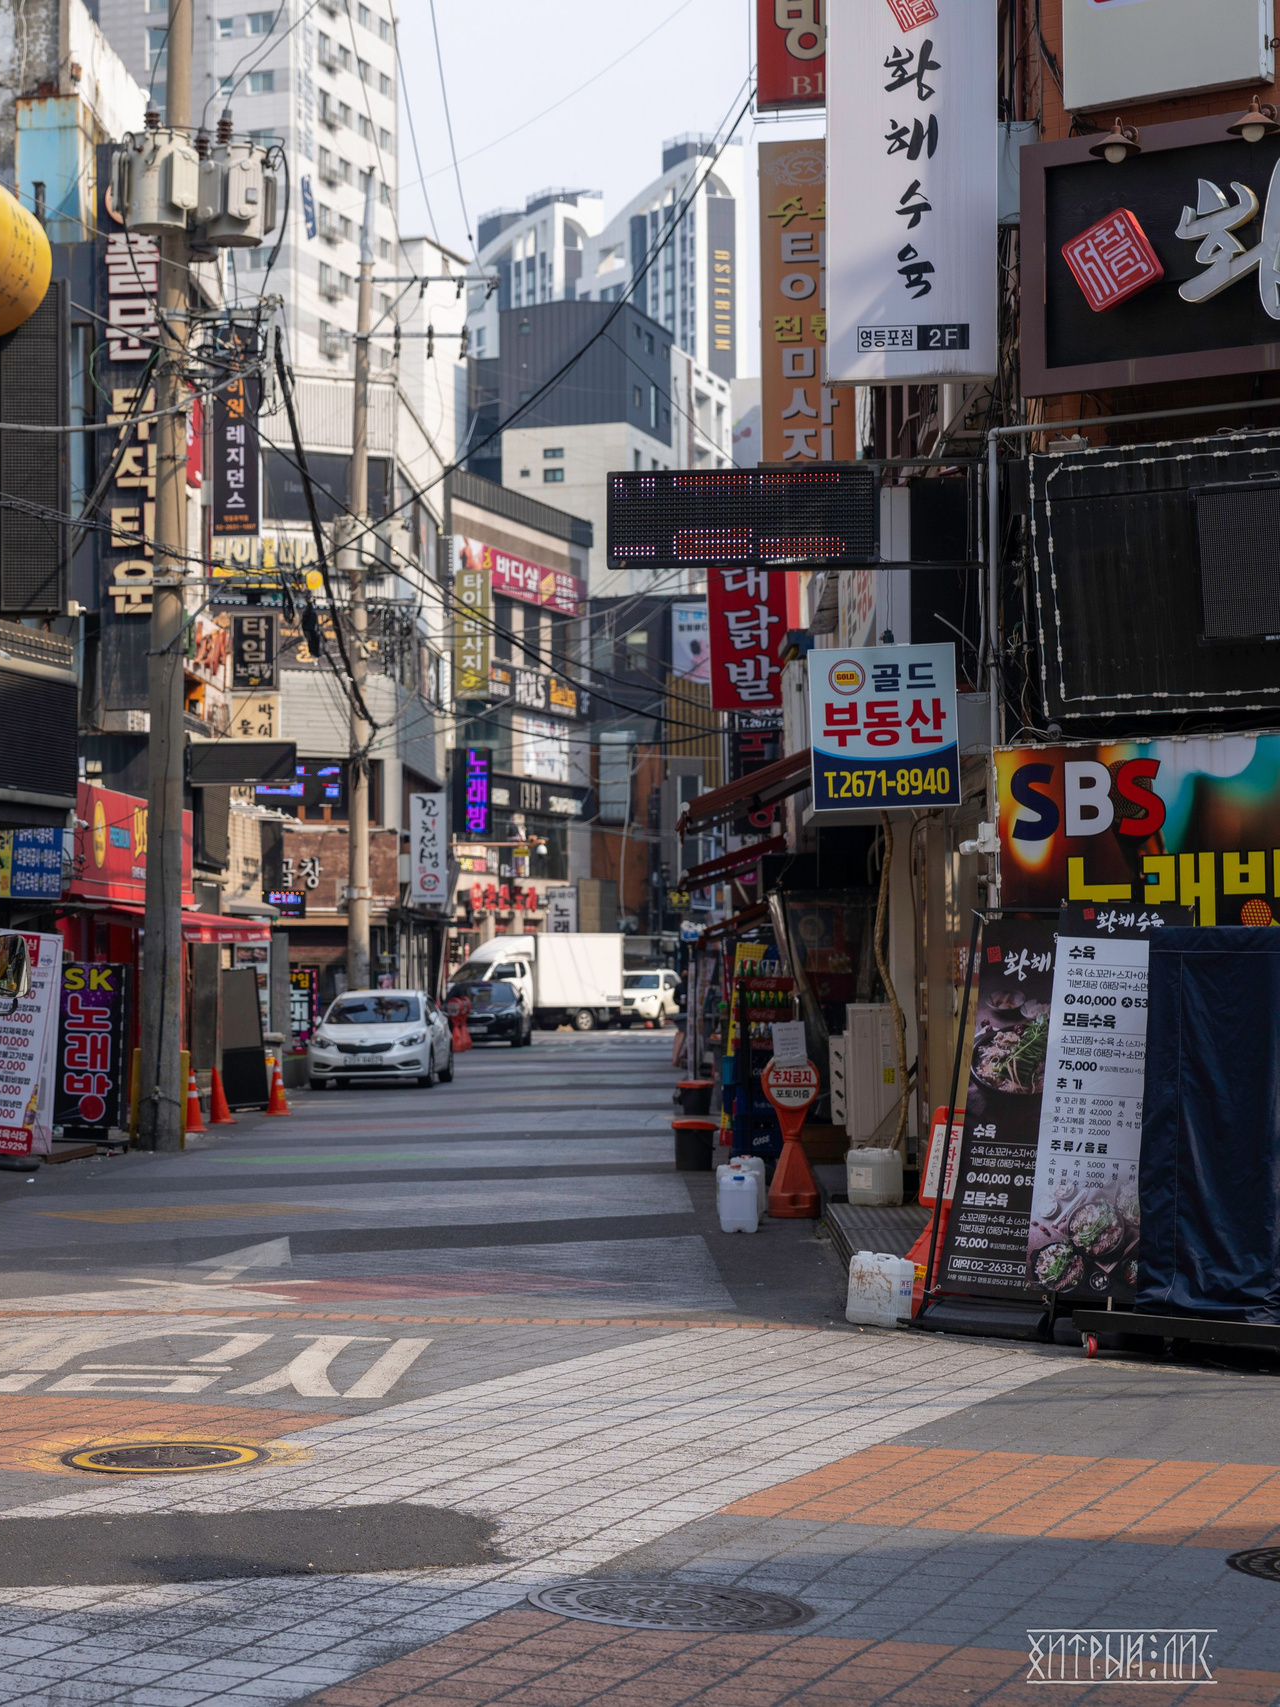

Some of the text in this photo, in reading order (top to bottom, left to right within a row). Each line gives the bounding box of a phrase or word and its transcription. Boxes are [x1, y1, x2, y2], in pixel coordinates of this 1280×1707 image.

[883, 38, 942, 300] 황해수육
[859, 327, 959, 347] 영등포점 2F
[225, 424, 246, 509] 레지던스
[279, 538, 334, 568] 마사
[242, 617, 269, 663] 타임
[835, 672, 856, 682] GOLD
[871, 662, 936, 692] 골드
[823, 697, 947, 748] 부동산
[823, 766, 950, 799] T.2671-8940
[467, 750, 489, 831] 노래방
[1010, 757, 1167, 842] SBS
[1096, 910, 1165, 934] 황해수육
[1068, 945, 1095, 960] 수육
[63, 967, 114, 992] SK
[1067, 968, 1083, 978] 수육
[1066, 979, 1098, 990] 기본제공
[1077, 995, 1117, 1007] 40,000
[1062, 1012, 1116, 1029] 모듬수육
[1060, 1035, 1114, 1046] 소꼬리찜+수육
[1116, 1037, 1125, 1046] 소
[64, 993, 113, 1122] 노래방
[1060, 1046, 1146, 1061] 기본제공 (해장국+소면)
[1058, 1060, 1097, 1071] 75,000
[772, 1070, 812, 1084] 주차금지
[775, 1089, 810, 1099] 포토이즘
[1091, 1098, 1113, 1107] 47,000
[1089, 1108, 1112, 1117] 42,000
[1088, 1118, 1111, 1127] 28,000
[972, 1124, 997, 1139] 수육
[1087, 1128, 1110, 1137] 22,000
[971, 1146, 985, 1156] 수육
[1050, 1140, 1108, 1155] 주류/음료
[970, 1156, 996, 1168] 기본제공
[1087, 1161, 1106, 1169] 5,000
[977, 1173, 1011, 1185] 40,000
[1086, 1171, 1105, 1179] 5,000
[1084, 1180, 1104, 1189] 2,000
[962, 1190, 1009, 1208] 모듬수육
[959, 1213, 1006, 1225] 소꼬리찜+수육
[1006, 1216, 1014, 1225] 소
[958, 1223, 985, 1235] 기본제공
[954, 1236, 988, 1249] 75,000
[952, 1258, 970, 1270] 예약
